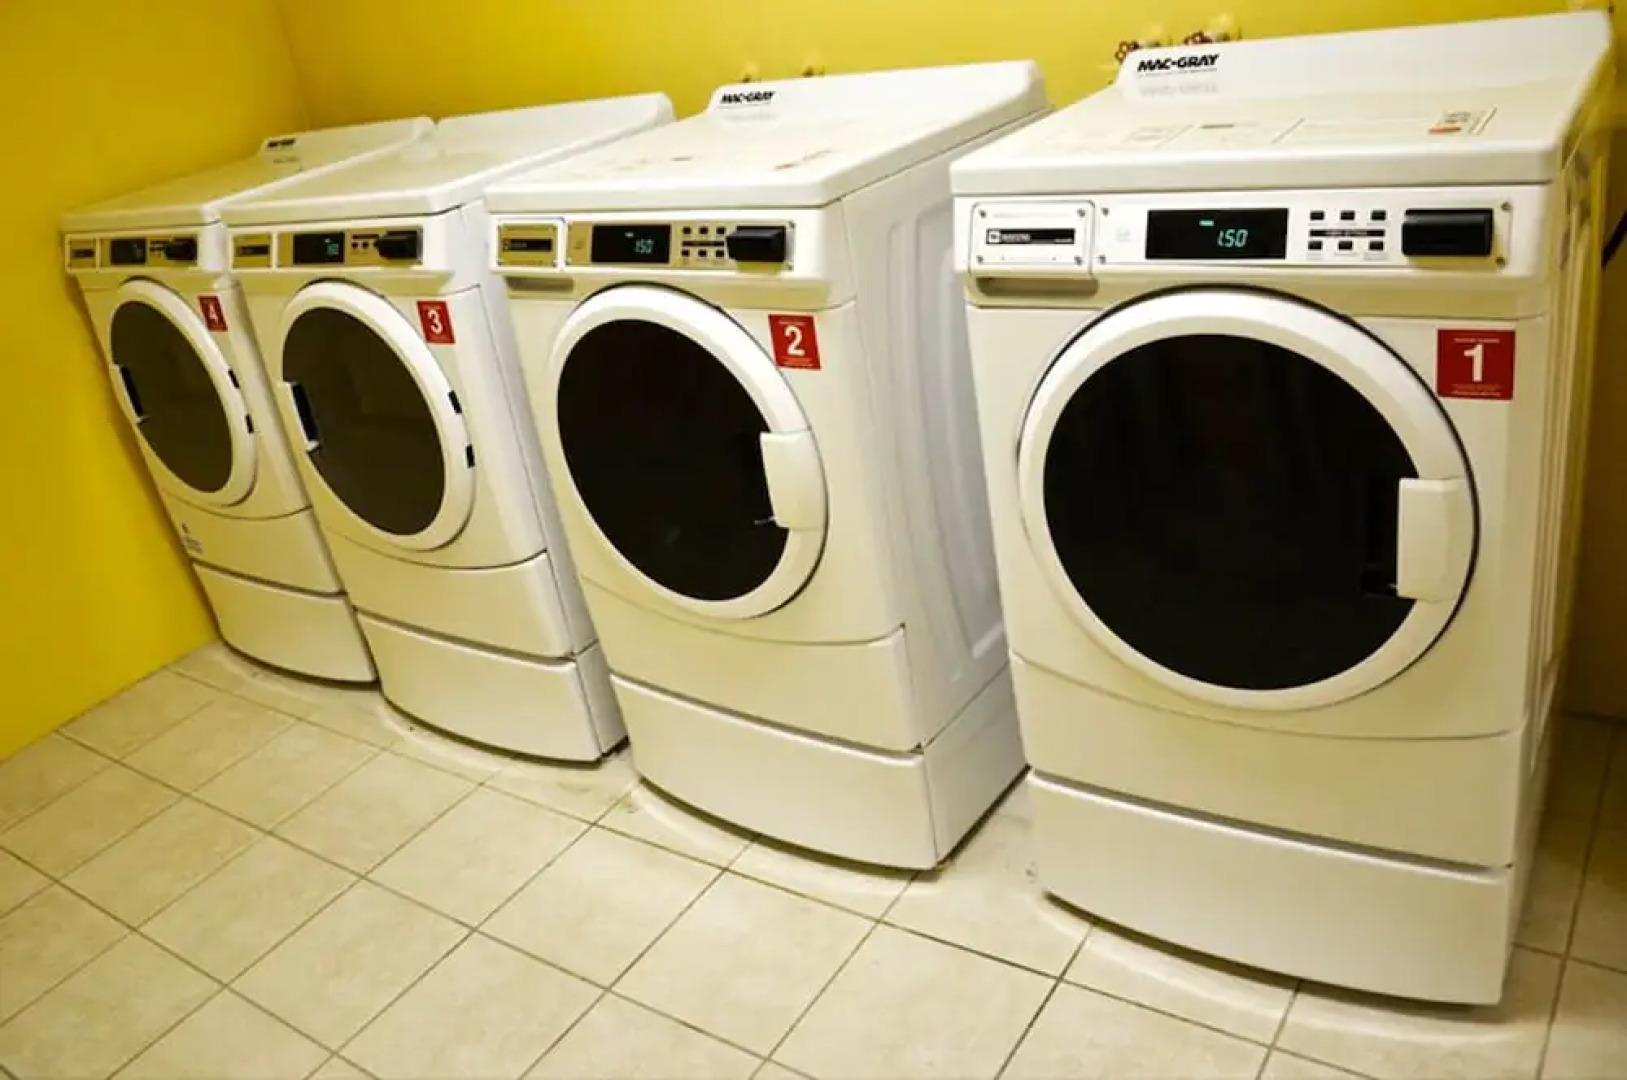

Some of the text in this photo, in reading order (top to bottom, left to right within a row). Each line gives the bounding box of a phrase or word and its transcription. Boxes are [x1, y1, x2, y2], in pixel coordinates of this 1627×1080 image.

[1137, 54, 1219, 72] MAC-GRAY
[208, 303, 219, 325] 4
[427, 309, 443, 335] 3
[784, 325, 806, 356] 2
[1463, 343, 1484, 382] 1
